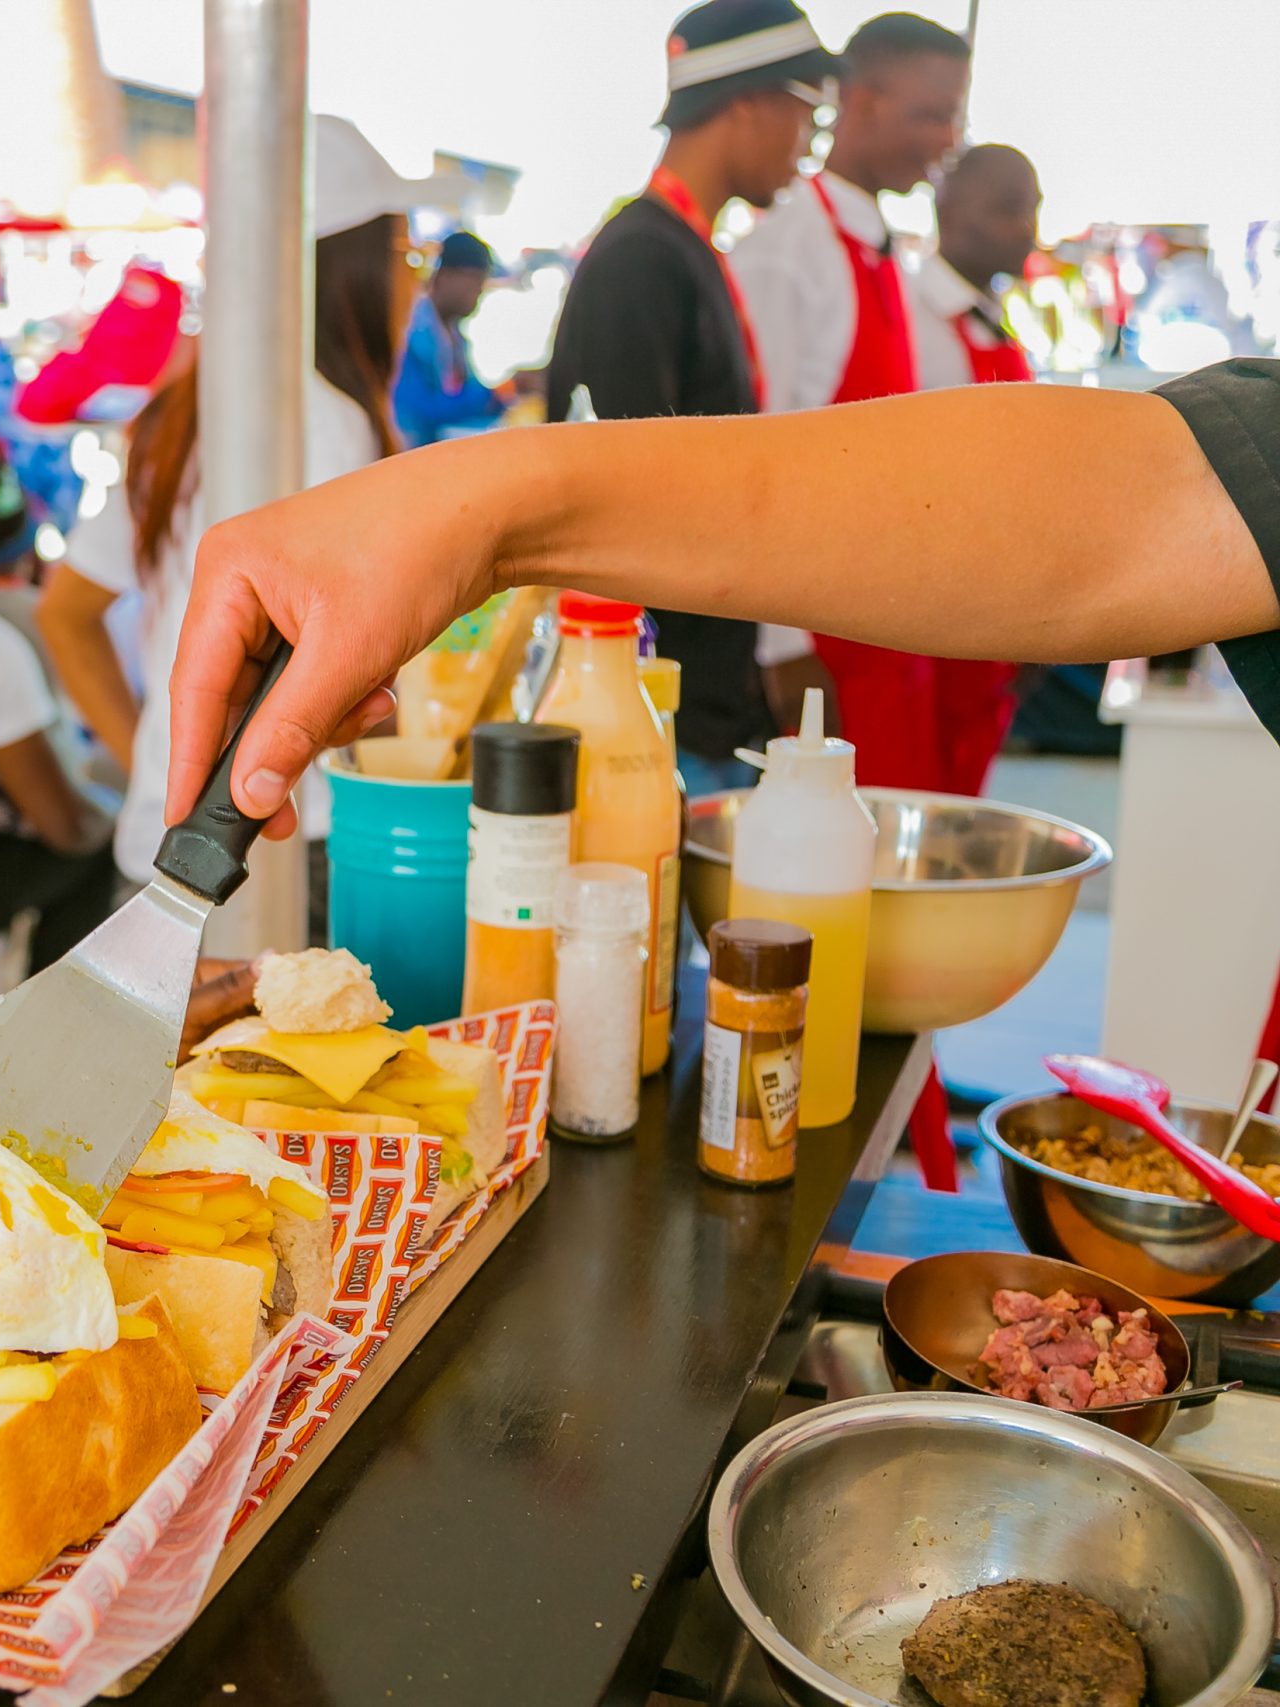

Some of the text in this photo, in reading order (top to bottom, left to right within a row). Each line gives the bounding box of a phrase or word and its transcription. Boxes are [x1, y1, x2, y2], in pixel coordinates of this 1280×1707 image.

[330, 1144, 352, 1198] SASKO
[366, 1186, 396, 1229] SASKO
[346, 1249, 375, 1294] SASKO
